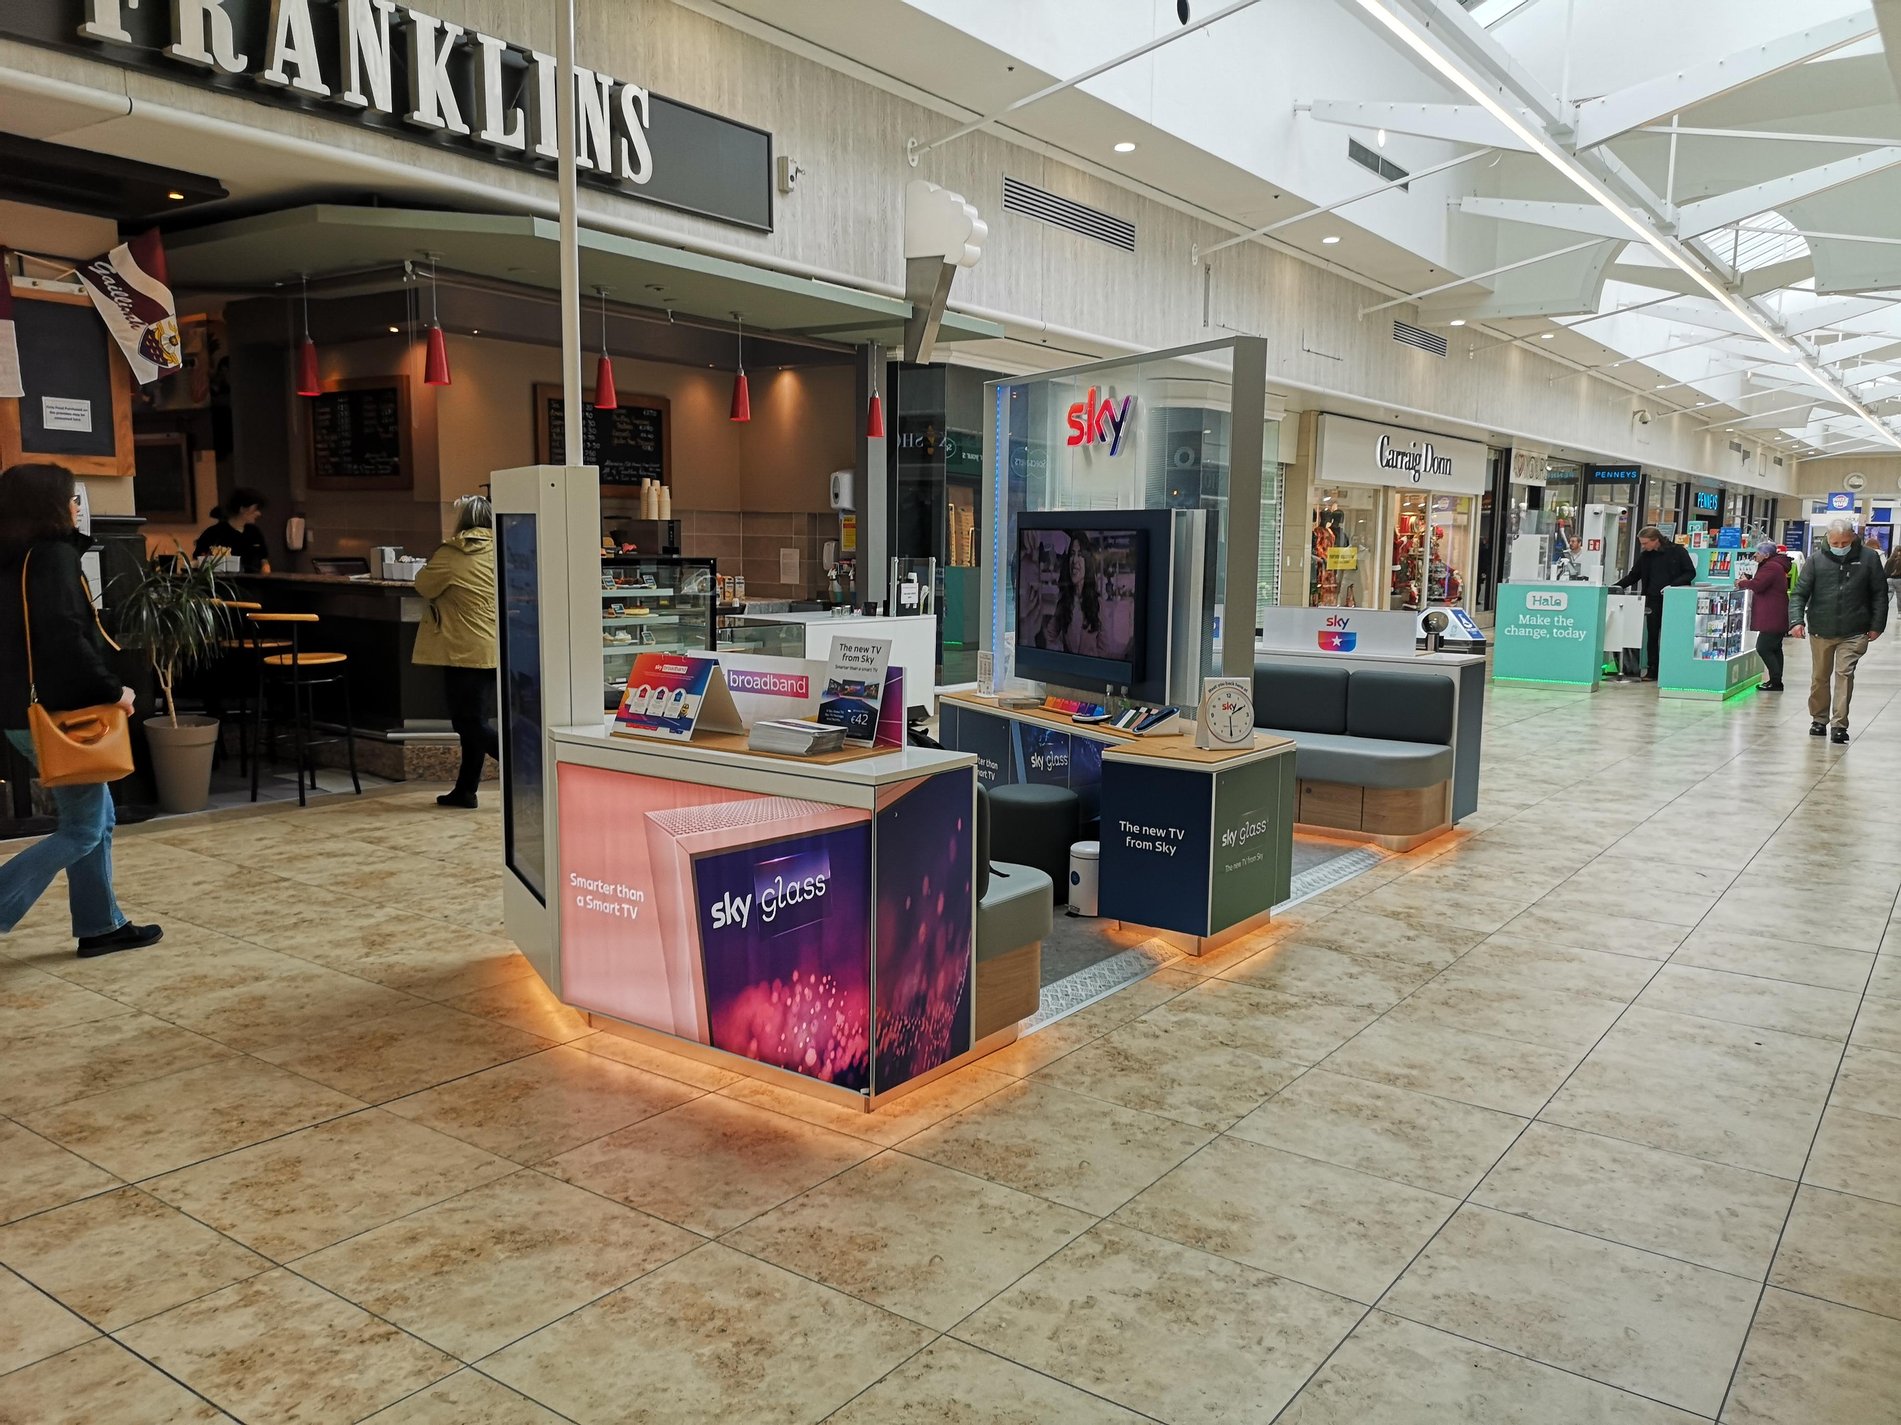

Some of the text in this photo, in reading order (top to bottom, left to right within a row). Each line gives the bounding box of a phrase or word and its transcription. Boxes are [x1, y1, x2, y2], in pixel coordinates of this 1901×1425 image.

[1067, 385, 1132, 456] sky
[1378, 434, 1452, 482] Carraig Donn
[1697, 491, 1718, 511] PENNEYS
[1326, 614, 1350, 630] sky
[1519, 614, 1574, 626] Make the
[1504, 625, 1587, 641] change, today
[840, 643, 852, 652] The
[872, 646, 882, 654] TV
[842, 653, 874, 665] from Sky
[730, 671, 806, 694] broadband
[1222, 701, 1236, 712] sky
[850, 714, 868, 726] €42
[1030, 751, 1068, 771] sky glass
[988, 770, 996, 780] TV
[1119, 820, 1184, 840] The new TV
[1222, 821, 1266, 847] sky glass
[1126, 836, 1176, 856] from Sky
[570, 872, 644, 902] Smarter than
[577, 895, 638, 919] a Smart TV
[711, 874, 826, 929] sky glass
